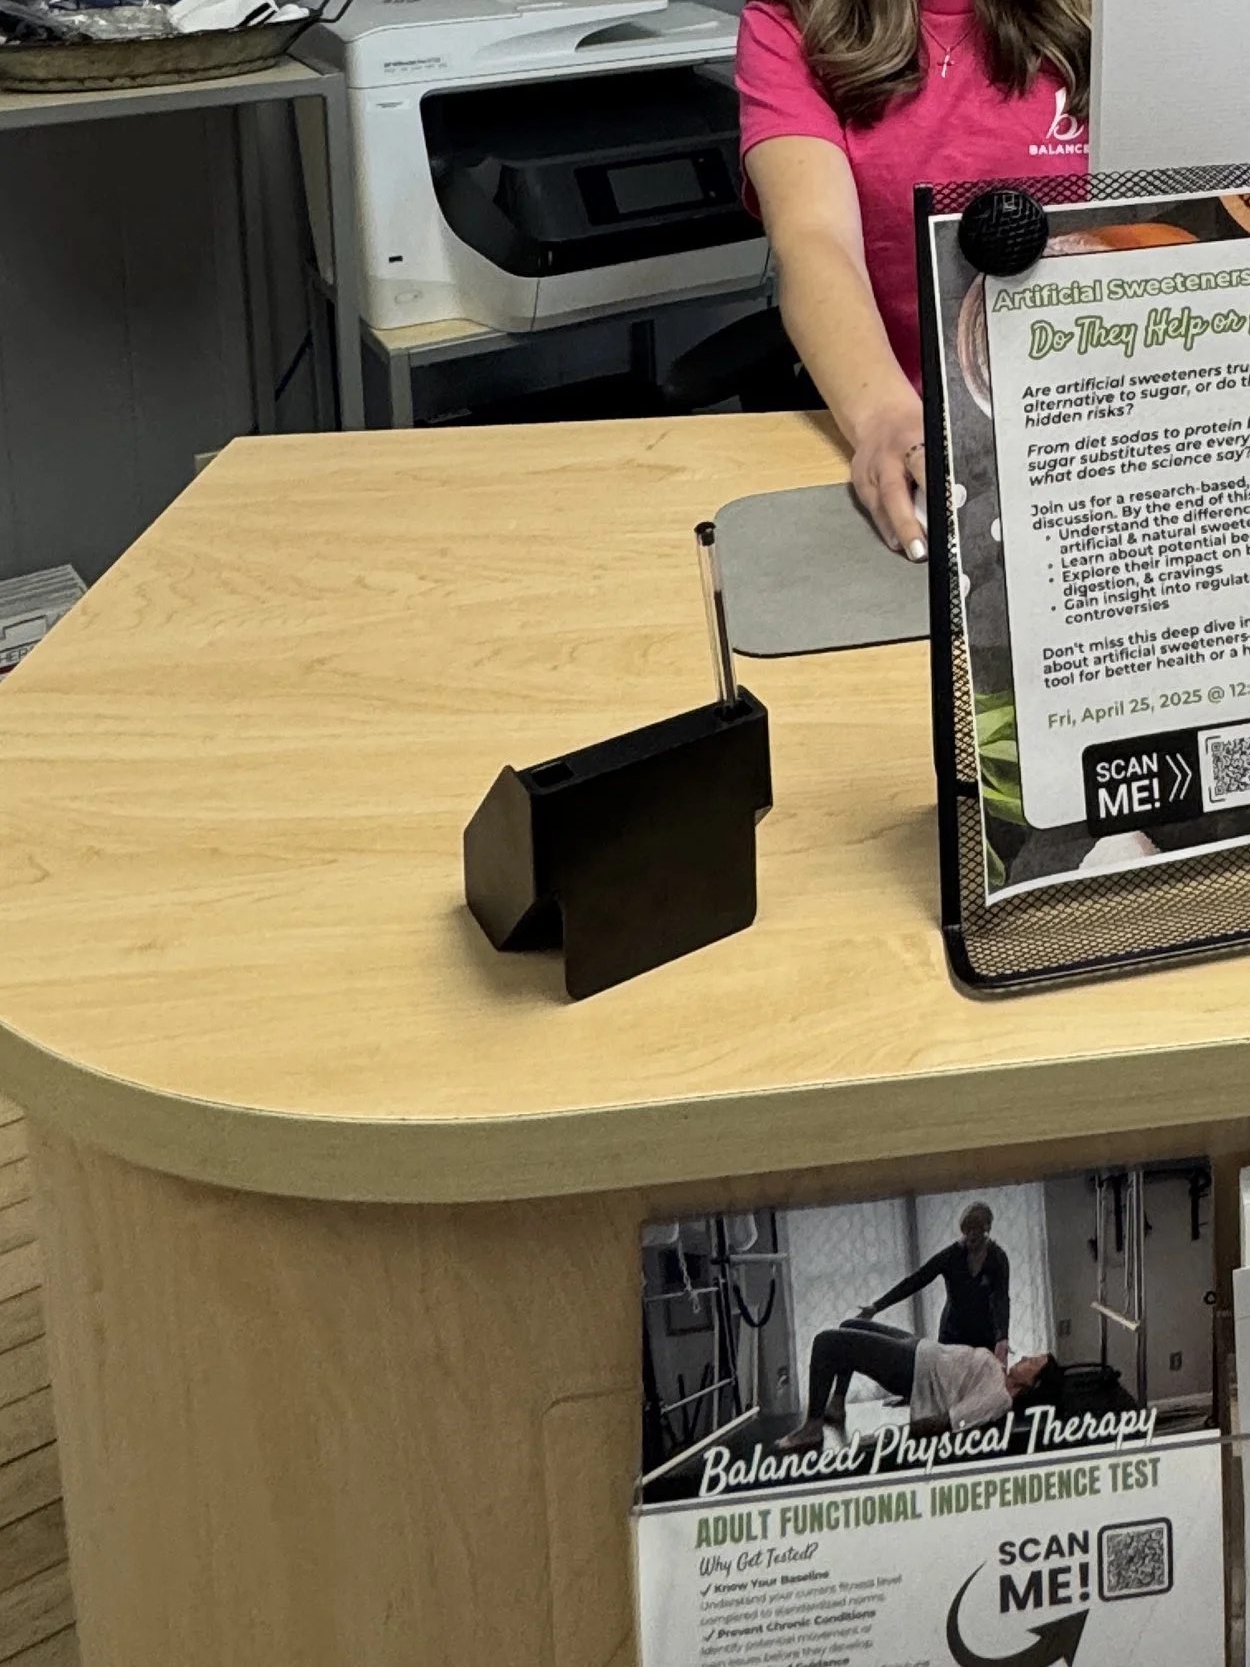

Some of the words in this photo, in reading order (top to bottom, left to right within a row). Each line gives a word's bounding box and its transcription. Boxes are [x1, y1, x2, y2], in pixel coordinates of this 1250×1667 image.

[992, 279, 1103, 313] Artificial
[1028, 319, 1076, 361] Do
[1075, 314, 1137, 360] They
[1144, 307, 1209, 351] Help
[1211, 309, 1247, 334] or
[1021, 385, 1052, 400] Are
[1055, 374, 1126, 395] artificial
[1128, 365, 1222, 387] sweeteners
[1024, 410, 1083, 429] hidden
[1086, 402, 1135, 421] risks?
[1027, 441, 1071, 459] From
[1074, 435, 1107, 451] diet
[1110, 430, 1159, 447] sodas
[1163, 427, 1181, 440] to
[1183, 418, 1243, 443] protein
[1027, 455, 1077, 474] sugar
[1079, 443, 1172, 465] substitutes
[1174, 439, 1203, 452] are
[1028, 468, 1073, 487] what
[1076, 465, 1116, 481] does
[1119, 459, 1148, 475] the
[1151, 452, 1213, 470] science
[1030, 500, 1065, 518] Join
[1068, 499, 1087, 512] us
[1089, 494, 1113, 509] for
[1116, 494, 1126, 505] a
[1129, 475, 1250, 503] research-based,
[1032, 508, 1119, 531] discussion.
[1121, 505, 1142, 523] By
[1145, 500, 1172, 515] the
[1174, 494, 1205, 511] end
[1208, 491, 1224, 507] of
[1058, 516, 1150, 541] Understand
[1152, 513, 1180, 528] the
[1060, 553, 1105, 569] Learn
[1108, 544, 1154, 562] about
[1158, 532, 1227, 558] potential
[1061, 565, 1121, 587] Explore
[1124, 555, 1161, 574] their
[1164, 549, 1220, 572] impact
[1221, 547, 1242, 560] on
[1062, 576, 1140, 601] digestion,
[1142, 571, 1155, 585] &
[1157, 563, 1224, 588] cravings
[1063, 593, 1099, 611] Gain
[1103, 585, 1158, 609] insight
[1160, 581, 1192, 596] into
[1064, 598, 1170, 626] controversies
[1042, 641, 1085, 661] Don't
[1088, 636, 1125, 652] miss
[1127, 630, 1158, 646] this
[1160, 625, 1201, 646] deep
[1203, 619, 1237, 634] dive
[1043, 671, 1075, 688] tool
[1078, 669, 1101, 683] for
[1104, 660, 1153, 679] better
[1156, 650, 1206, 670] health
[1209, 649, 1225, 662] or
[1229, 647, 1239, 659] a
[1047, 709, 1077, 730] Fri,
[1080, 700, 1125, 724] April
[1128, 696, 1155, 715] 25,
[1159, 688, 1203, 709] 2025
[1207, 685, 1226, 704] @
[1096, 752, 1158, 783] SCAN
[1098, 784, 1161, 819] ME!
[698, 1428, 866, 1497] Balanced
[869, 1410, 1016, 1475] Physical
[1024, 1404, 1158, 1455] Therapy
[694, 1508, 772, 1549] ADULT
[779, 1490, 923, 1539] FUNCTIONAL
[929, 1465, 1102, 1518] INDEPENDENCE
[1108, 1457, 1161, 1493] TEST
[699, 1555, 733, 1578] Why
[736, 1551, 763, 1572] Get
[766, 1541, 819, 1569] Tested?
[998, 1529, 1090, 1566] SCAN
[999, 1561, 1091, 1614] ME!
